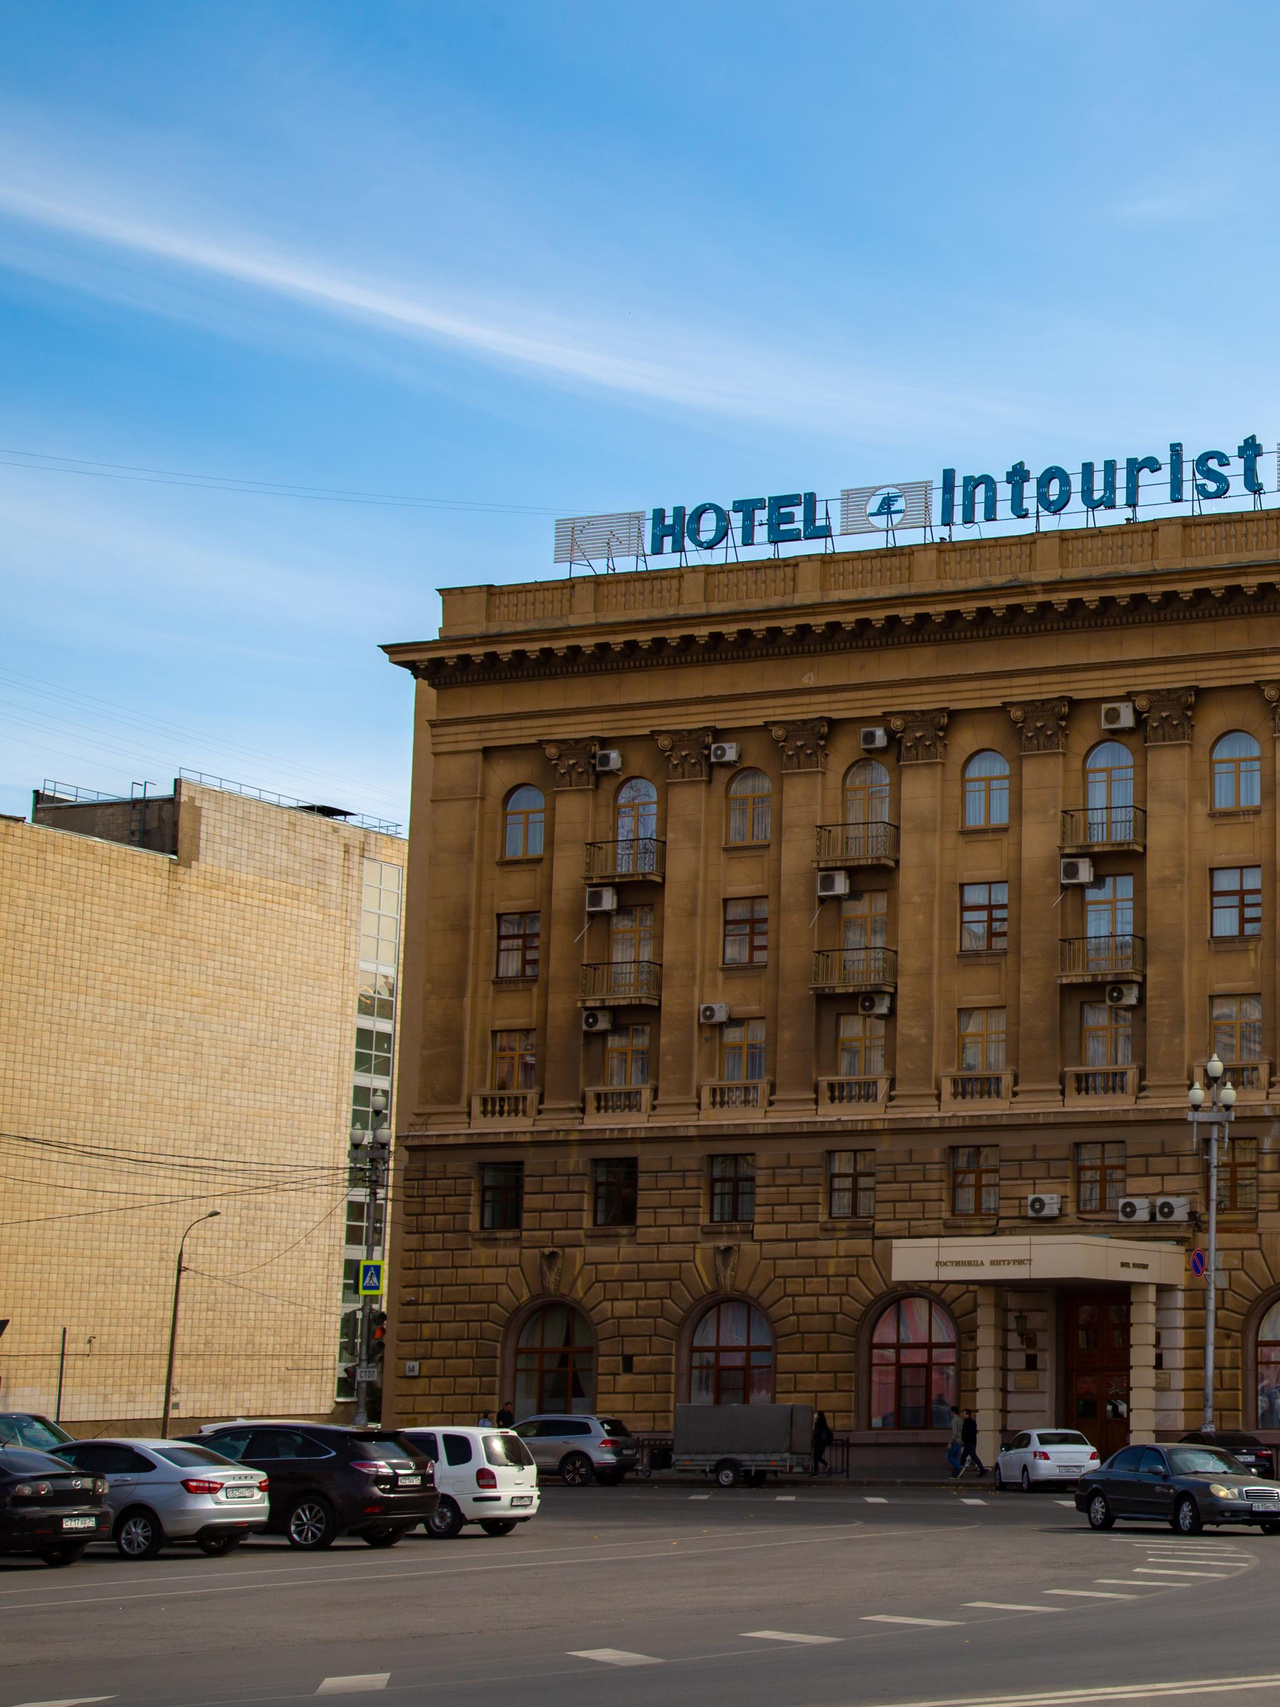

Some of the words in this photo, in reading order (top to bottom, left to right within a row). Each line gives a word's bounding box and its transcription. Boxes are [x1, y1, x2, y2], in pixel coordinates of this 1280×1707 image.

[651, 491, 832, 554] HOTEL
[941, 434, 1263, 526] Intourist
[989, 1258, 1033, 1267] ИНТУРИСТ
[360, 1370, 376, 1379] СТОП
